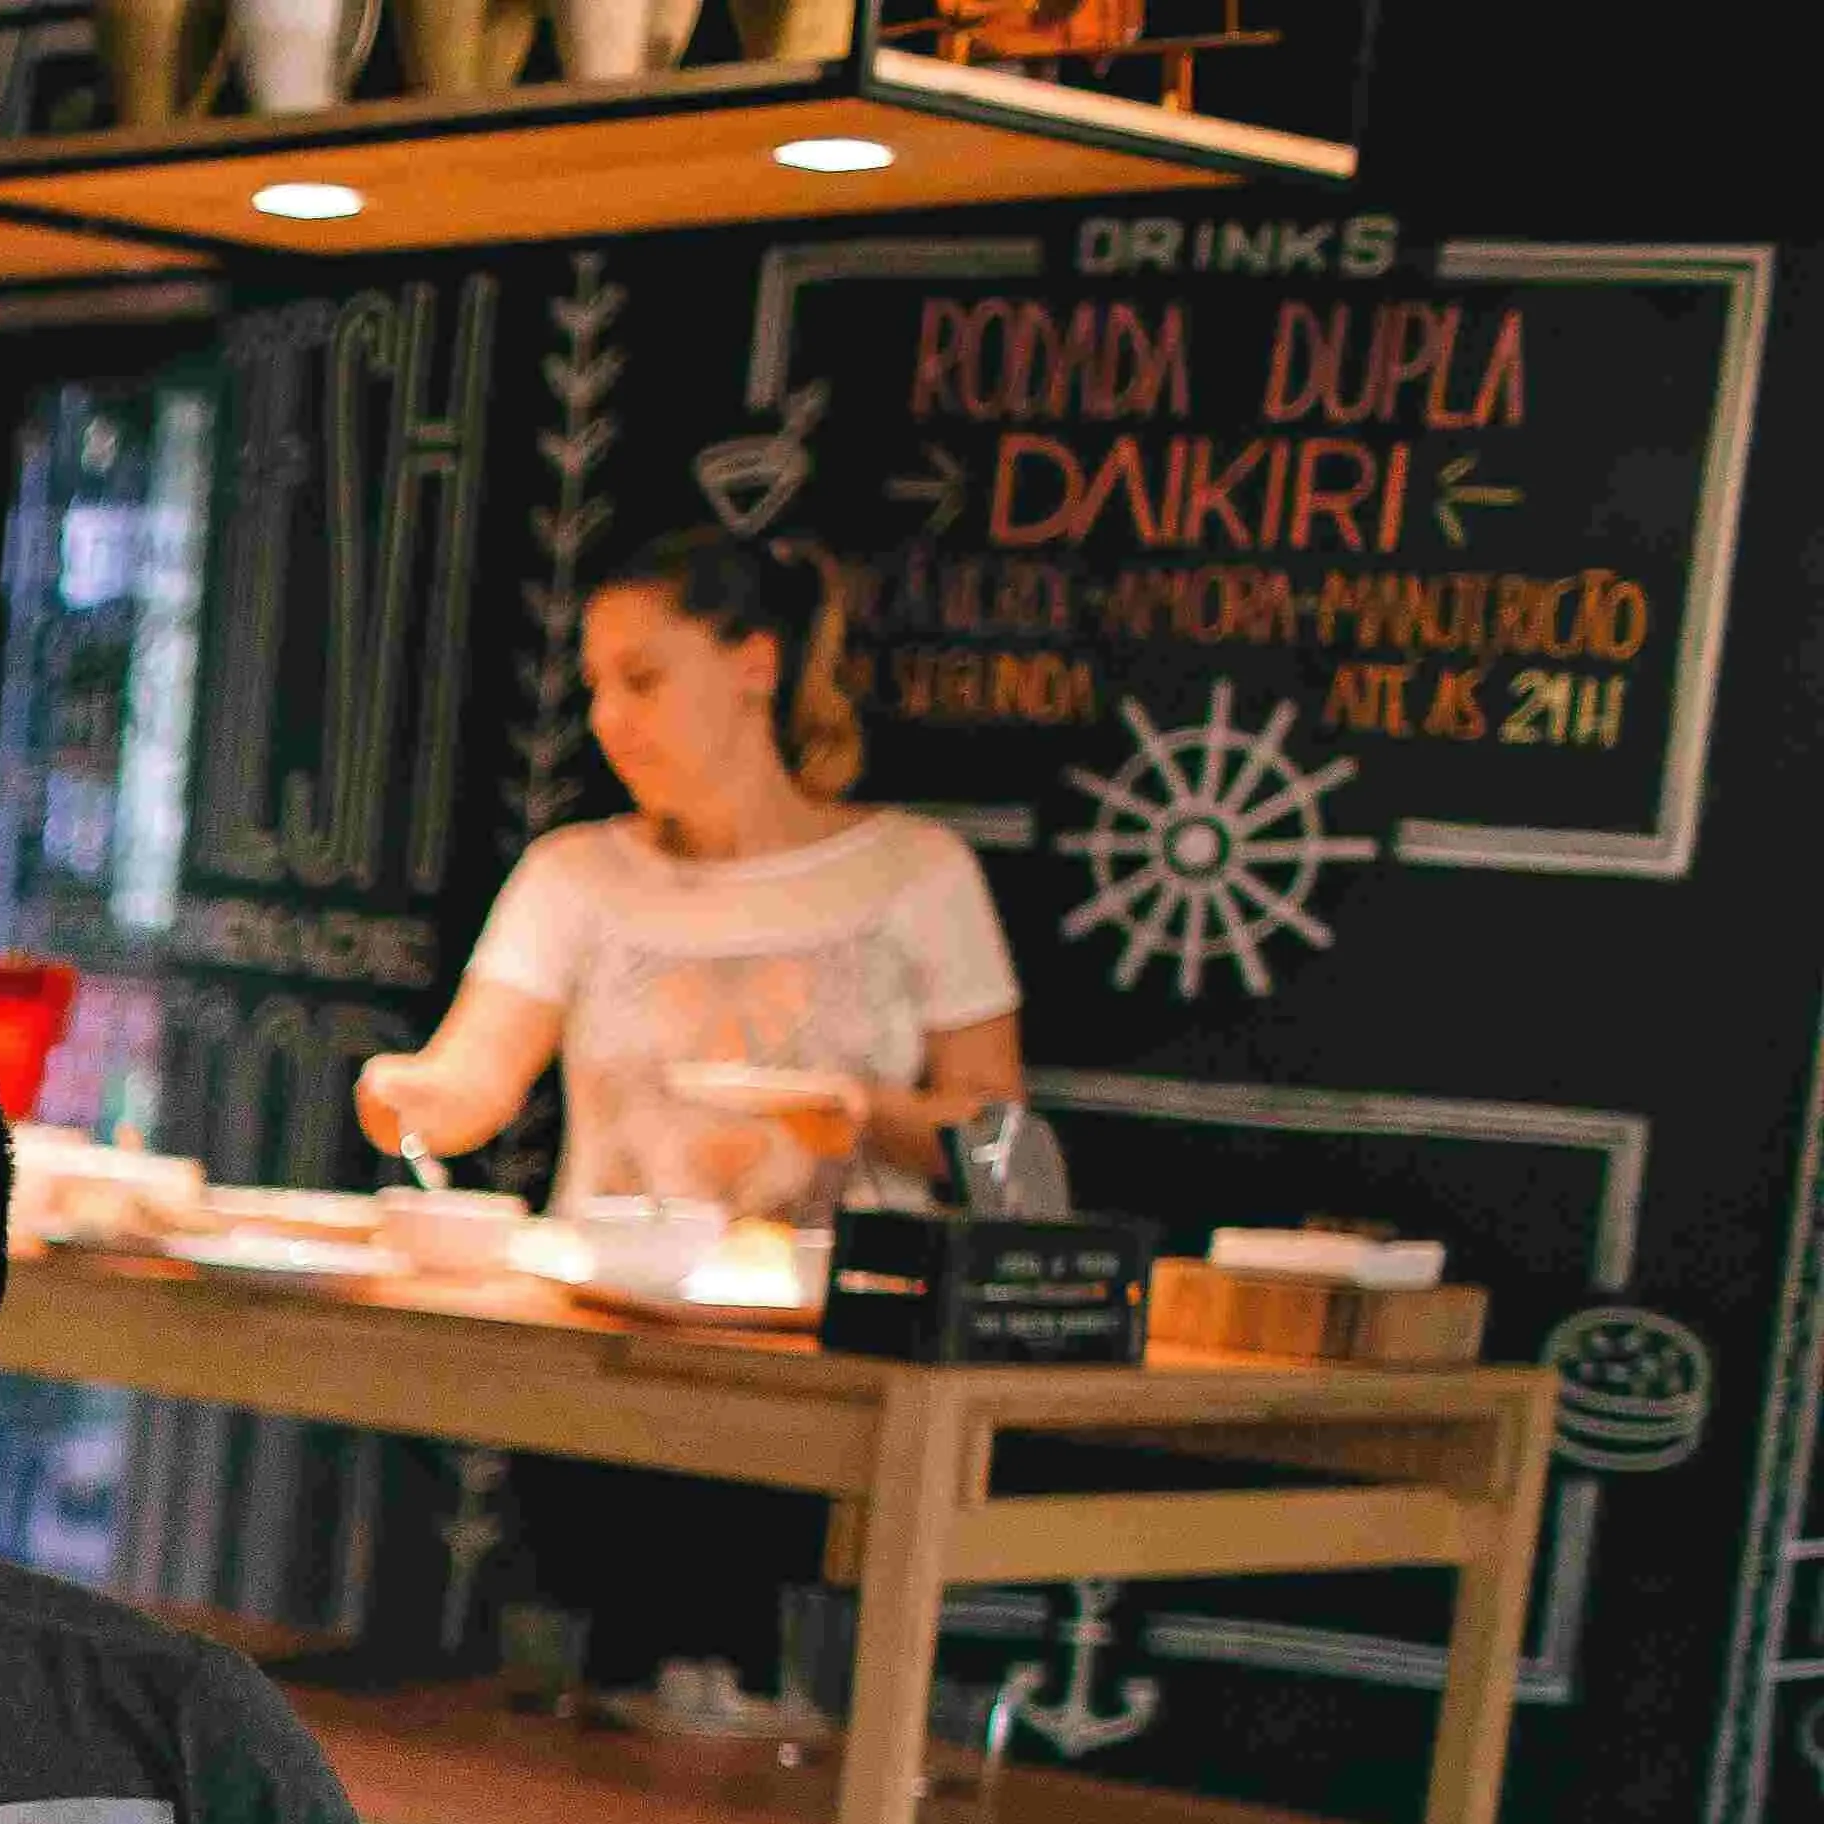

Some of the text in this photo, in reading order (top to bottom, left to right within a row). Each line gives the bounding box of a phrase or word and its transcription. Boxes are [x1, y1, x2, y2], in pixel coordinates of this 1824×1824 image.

[1074, 214, 1400, 276] DRINKS
[1262, 300, 1524, 428] DUPLA
[988, 432, 1410, 552] DAIKIRI
[1498, 668, 1627, 749] 21H
